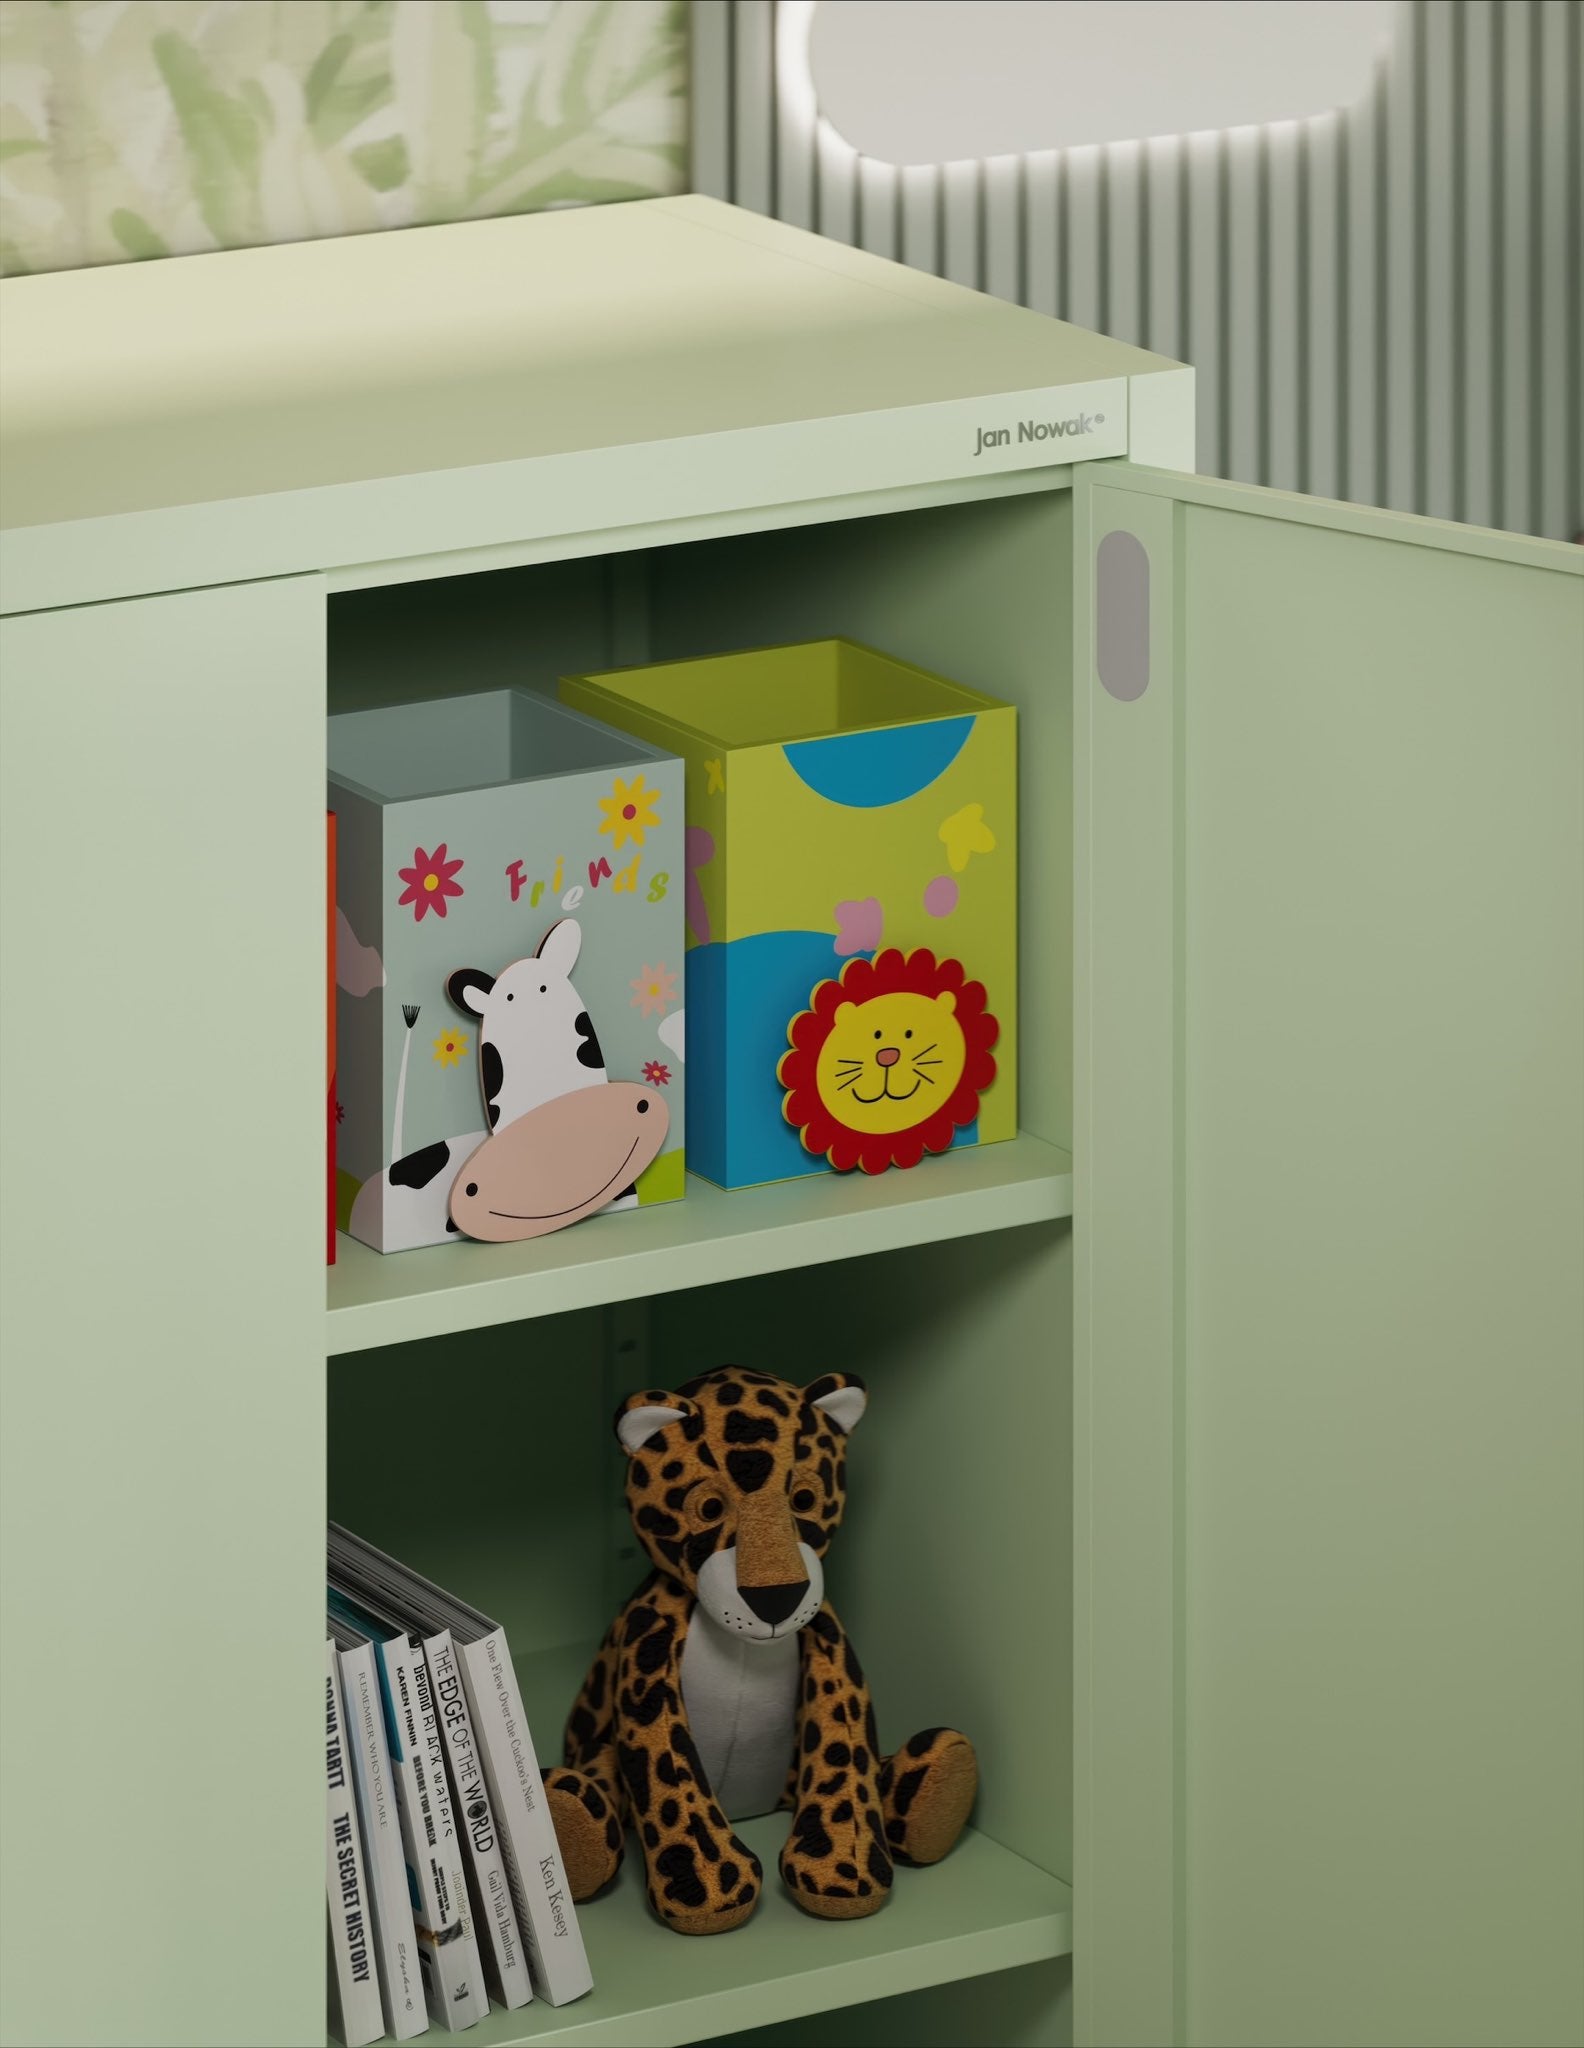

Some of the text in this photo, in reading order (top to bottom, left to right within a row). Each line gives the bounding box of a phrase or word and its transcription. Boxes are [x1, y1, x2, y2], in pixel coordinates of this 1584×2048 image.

[973, 427, 1010, 456] Jan
[505, 852, 669, 911] Friends
[433, 1646, 453, 1676] THE
[396, 1666, 418, 1747] KAREN FINNIN
[438, 1675, 465, 1728] EDGE
[485, 1640, 535, 1812] One Flew Over the Cuckoo's Nest
[327, 1735, 345, 1789] TARTT
[358, 1671, 387, 1829] REMEMBER WHO YOU ARE
[452, 1728, 470, 1749] OF
[458, 1751, 477, 1781] THE
[413, 1755, 427, 1793] BEFORE
[420, 1792, 430, 1814] YOU
[333, 1812, 370, 1983] THE SECRET HISTORY
[487, 1870, 516, 1968] Gail Vida Hamburg
[540, 1856, 568, 1937] Ken Kesey
[461, 1917, 474, 1941] Paul
